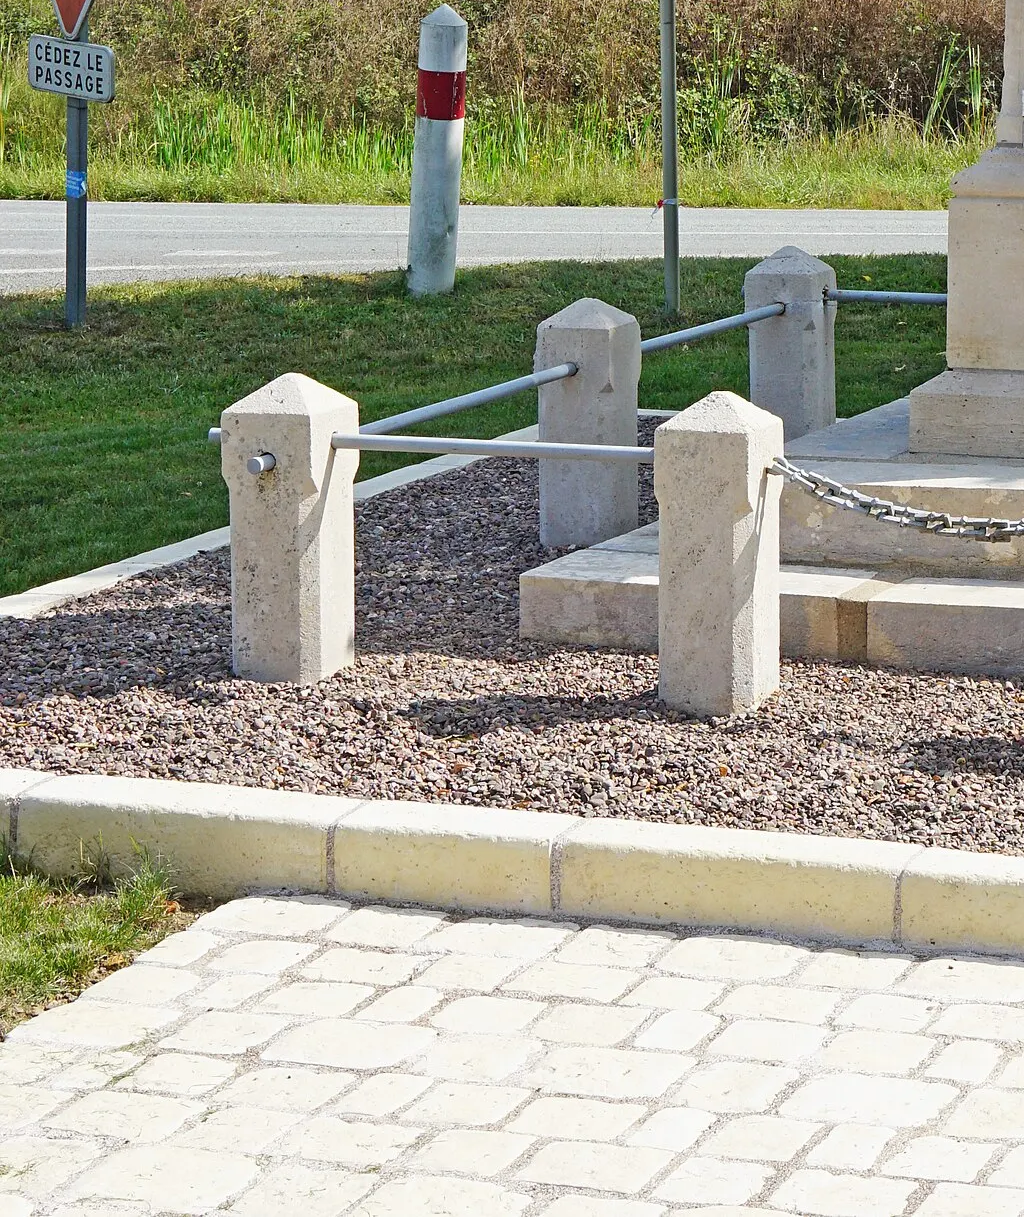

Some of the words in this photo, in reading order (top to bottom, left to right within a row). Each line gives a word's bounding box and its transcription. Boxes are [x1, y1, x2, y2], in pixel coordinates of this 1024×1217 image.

[35, 42, 80, 68] CÉDEZ
[87, 53, 103, 72] LE
[35, 65, 103, 94] PASSAGE
